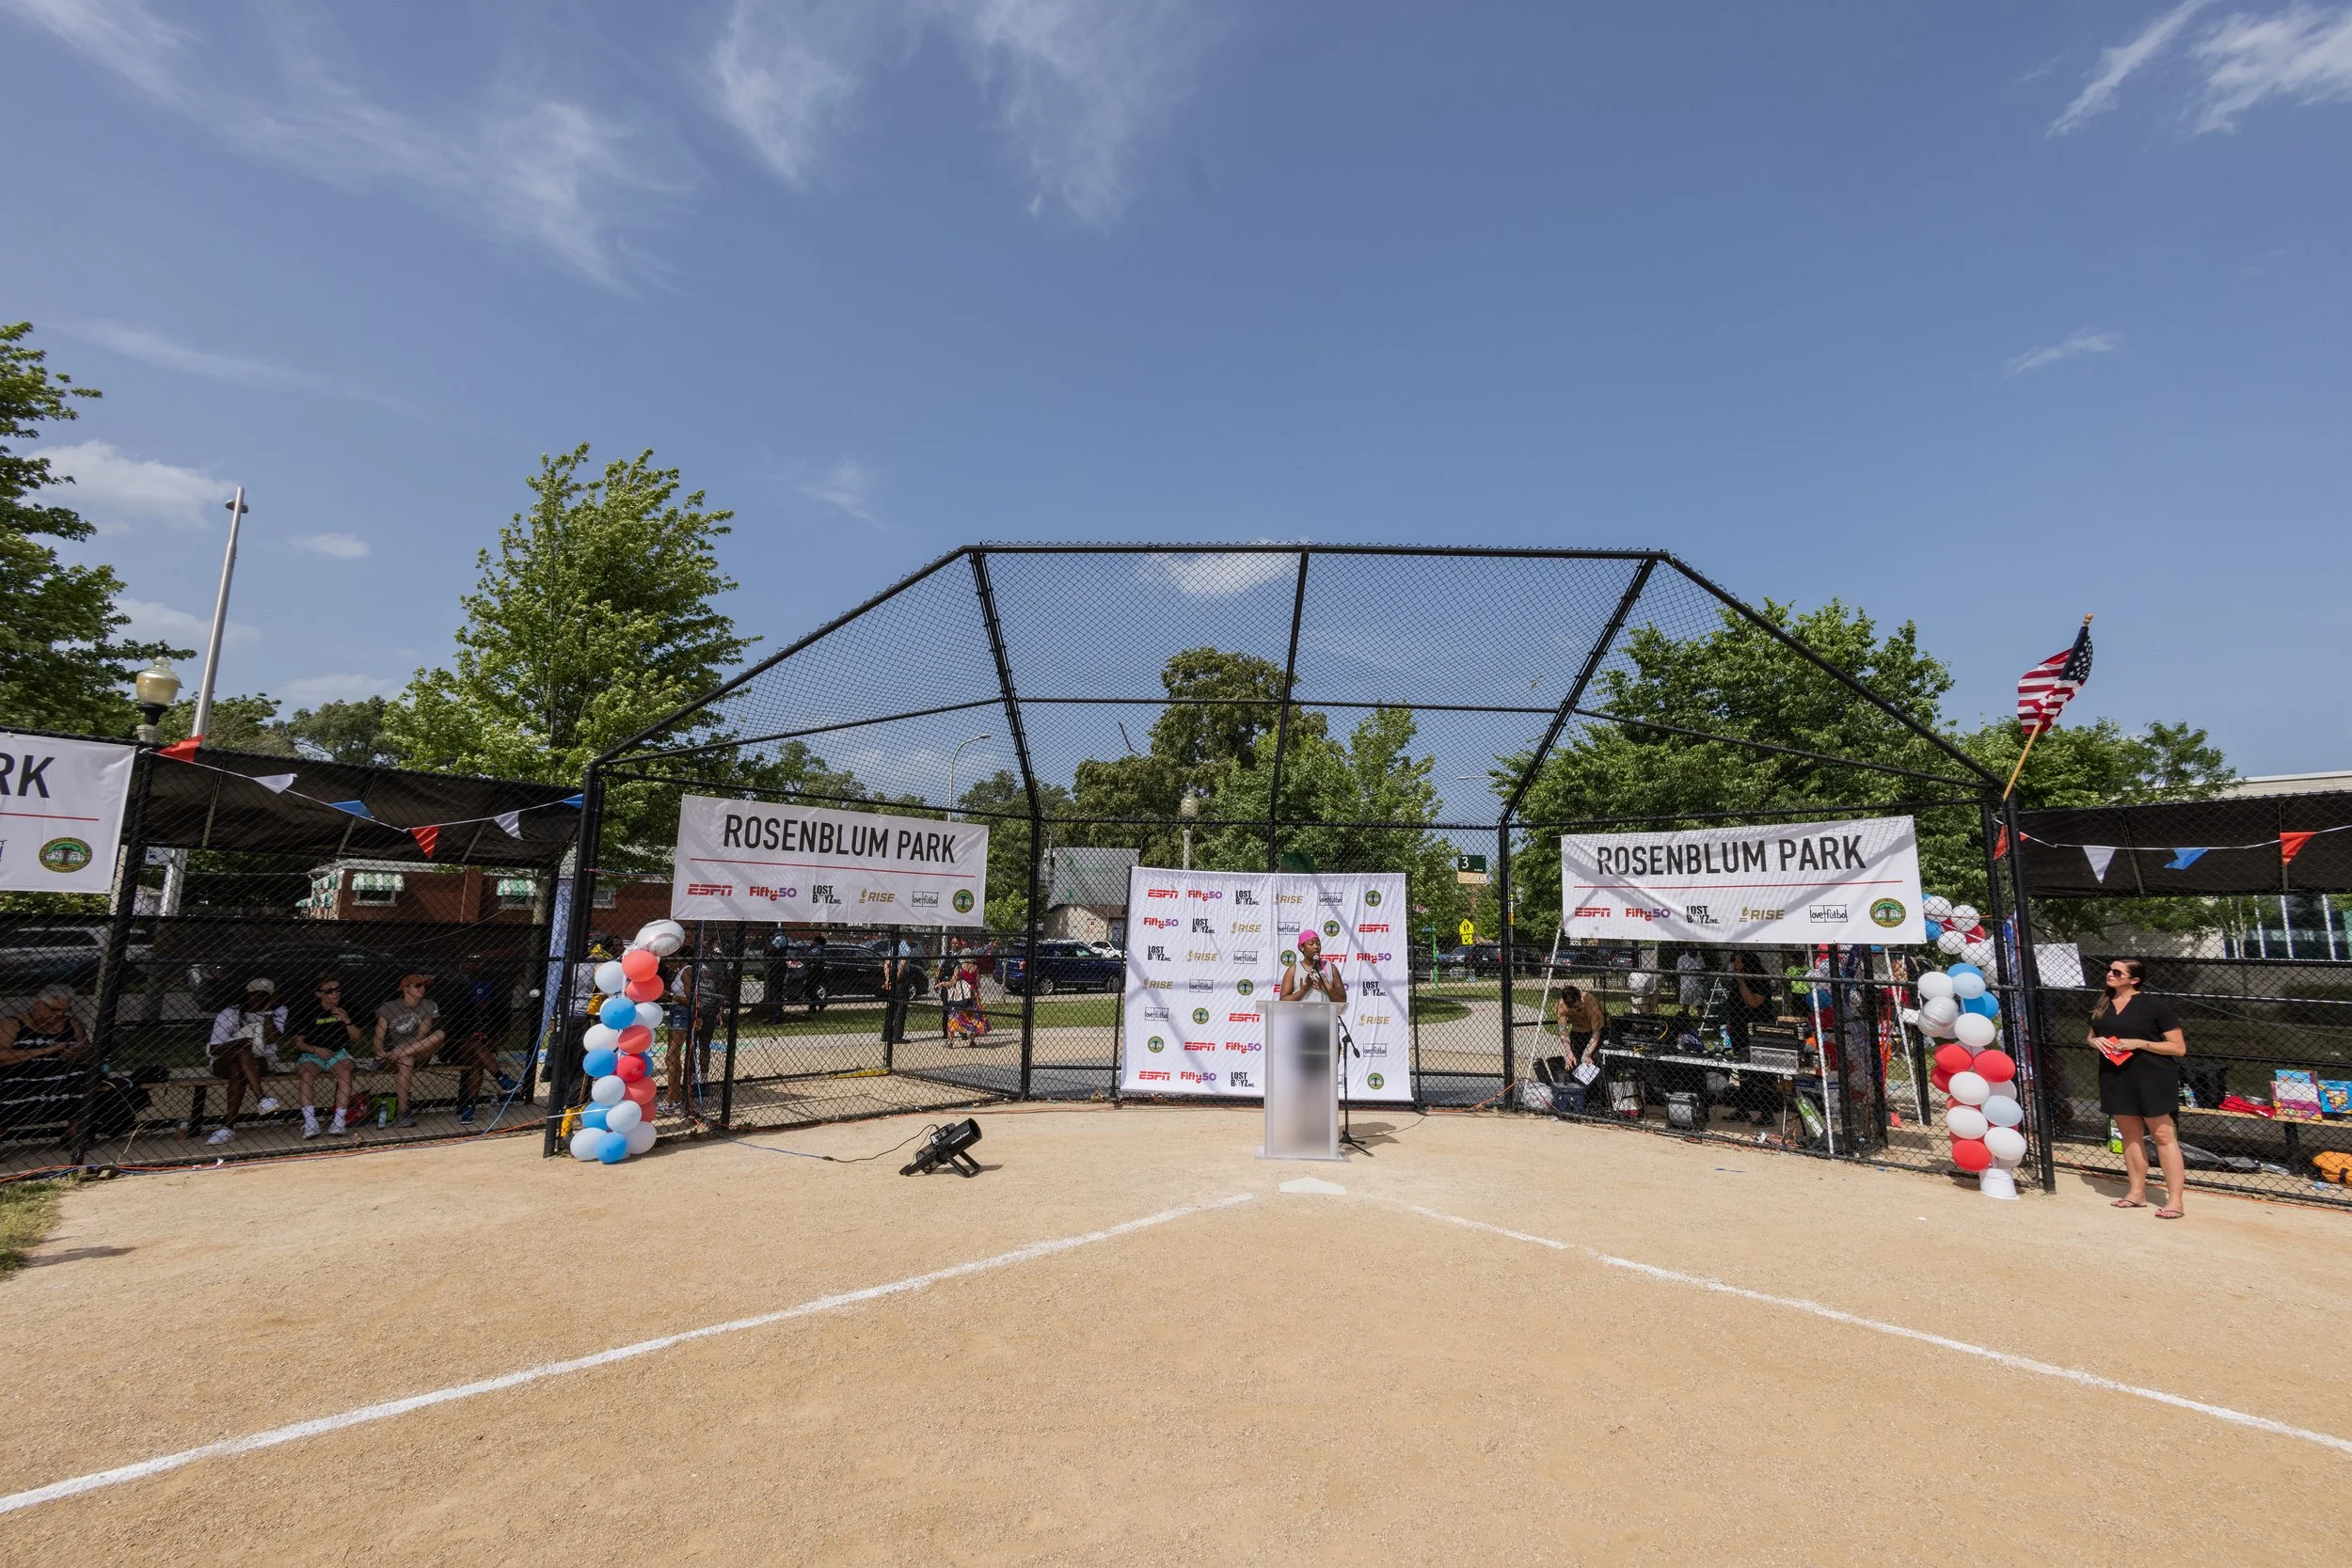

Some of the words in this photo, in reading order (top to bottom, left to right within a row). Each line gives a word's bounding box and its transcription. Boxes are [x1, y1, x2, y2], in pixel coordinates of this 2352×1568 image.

[723, 814, 889, 858] ROSENBLUM
[898, 831, 956, 863] PARK
[1597, 840, 1767, 876] ROSENBLUM
[1778, 835, 1867, 871] PARK
[1461, 856, 1470, 869] 3
[688, 884, 732, 896] ESPN
[813, 885, 833, 895] LOST
[1148, 889, 1178, 898] ESPN
[867, 893, 895, 902] RISE
[1574, 905, 1611, 917] ESPN
[1687, 906, 1709, 916] LOST
[1751, 910, 1785, 920] RISE
[1359, 924, 1389, 932] ESPN
[1149, 945, 1164, 954] LOST
[1229, 1013, 1260, 1022] ESPN
[1184, 1042, 1216, 1051] ESPN
[1139, 1071, 1170, 1081] ESPN
